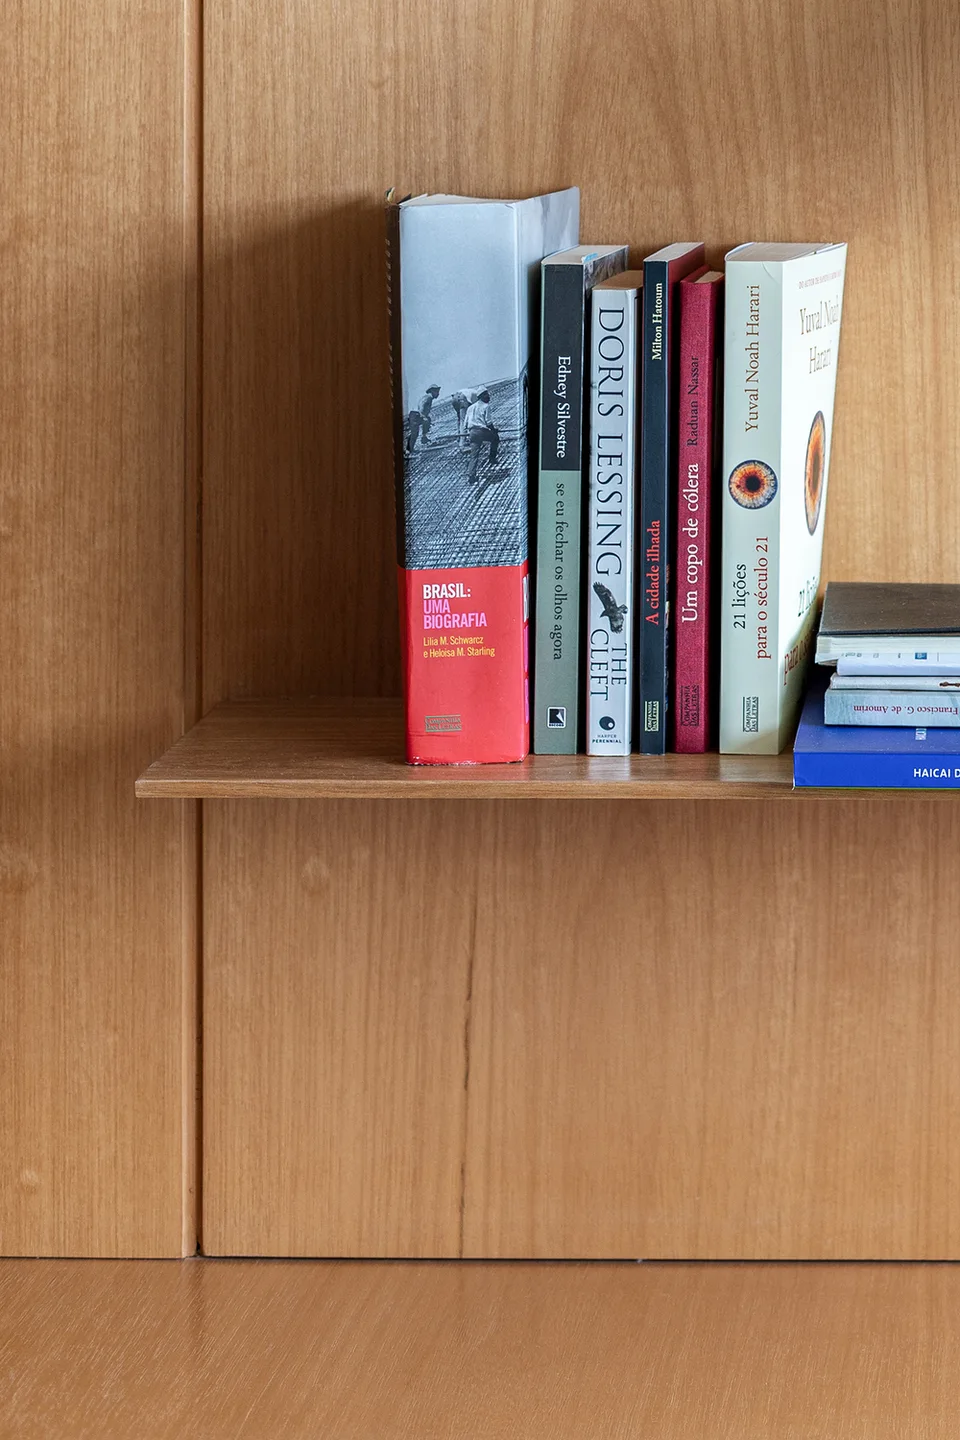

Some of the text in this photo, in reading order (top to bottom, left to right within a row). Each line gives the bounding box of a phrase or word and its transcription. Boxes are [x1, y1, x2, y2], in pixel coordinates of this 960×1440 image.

[652, 282, 663, 361] Milton Hatoum
[800, 301, 823, 335] Yuval
[745, 285, 760, 433] Yuval Noah Harari
[553, 356, 571, 459] Edney Silvestre
[687, 356, 699, 447] Raduan Nassar
[595, 307, 625, 575] DORIS LESSING
[681, 463, 703, 623] Um copo de cólera
[423, 583, 472, 599] BRASIL:
[549, 483, 569, 661] se eu fechar os olhos agora
[645, 519, 661, 625] A cidade ilhada
[423, 599, 451, 614] UMA
[732, 563, 750, 629] 21 lições
[754, 536, 772, 660] para o século 21
[423, 612, 488, 629] BIOGRAFIA
[423, 635, 484, 646] Lilia M. Schwarcz
[429, 649, 456, 658] Heloisa
[456, 647, 466, 657] M.
[467, 646, 496, 657] Starling
[590, 629, 609, 701] CLEFT
[611, 643, 627, 685] THE
[645, 701, 653, 732] COMPANHIA
[681, 685, 691, 727] COMPANHIA
[743, 697, 751, 732] COMPANHIA
[750, 719, 758, 732] DAS
[853, 705, 959, 715] Francisco G. de Amorim
[913, 768, 951, 778] HAICAI
